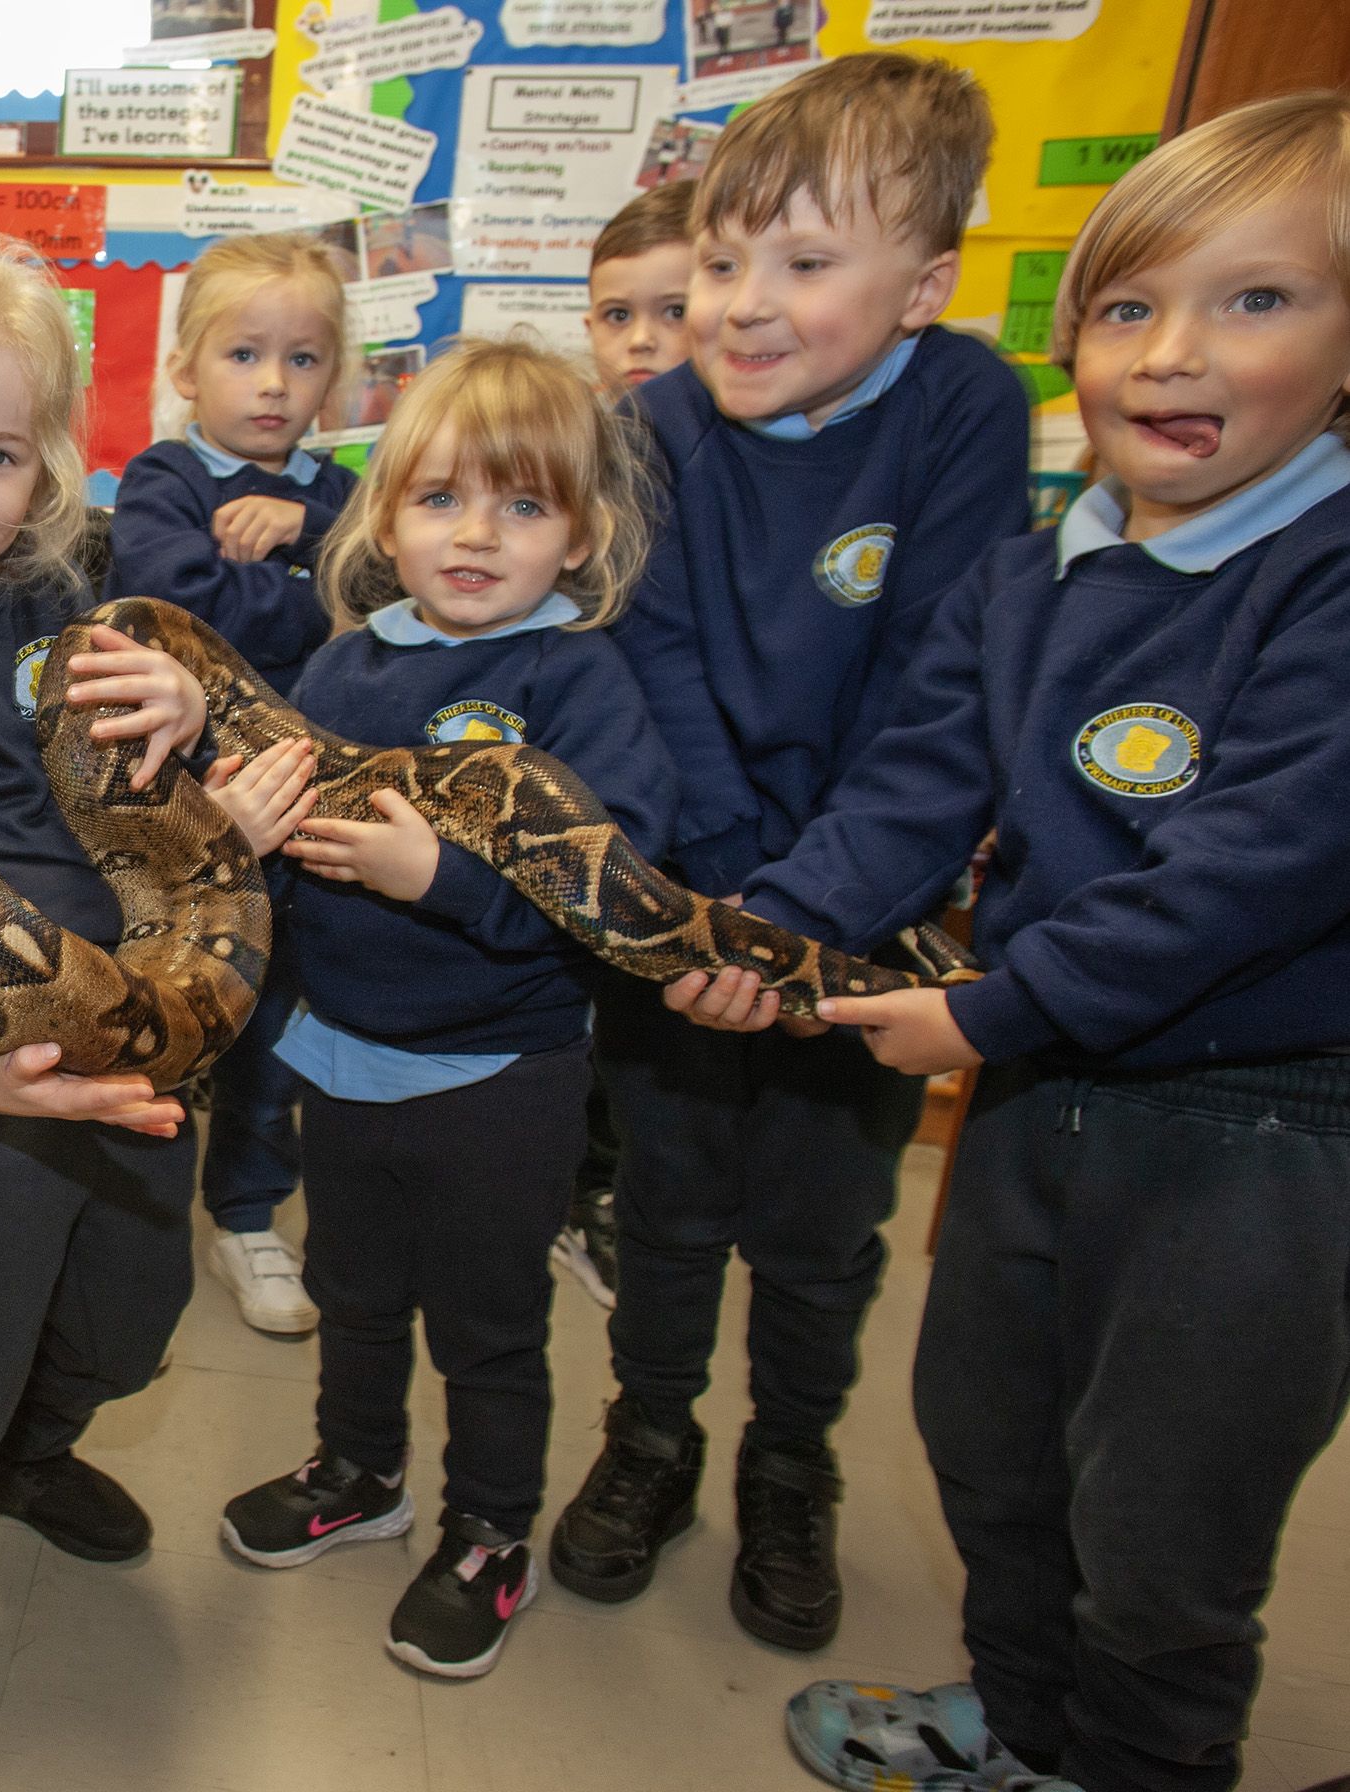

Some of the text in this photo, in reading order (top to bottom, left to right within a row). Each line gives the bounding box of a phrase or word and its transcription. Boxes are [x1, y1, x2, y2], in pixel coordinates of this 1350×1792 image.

[106, 83, 142, 97] use
[206, 79, 227, 97] of
[77, 103, 220, 124] the strateges
[499, 710, 525, 734] LISIE
